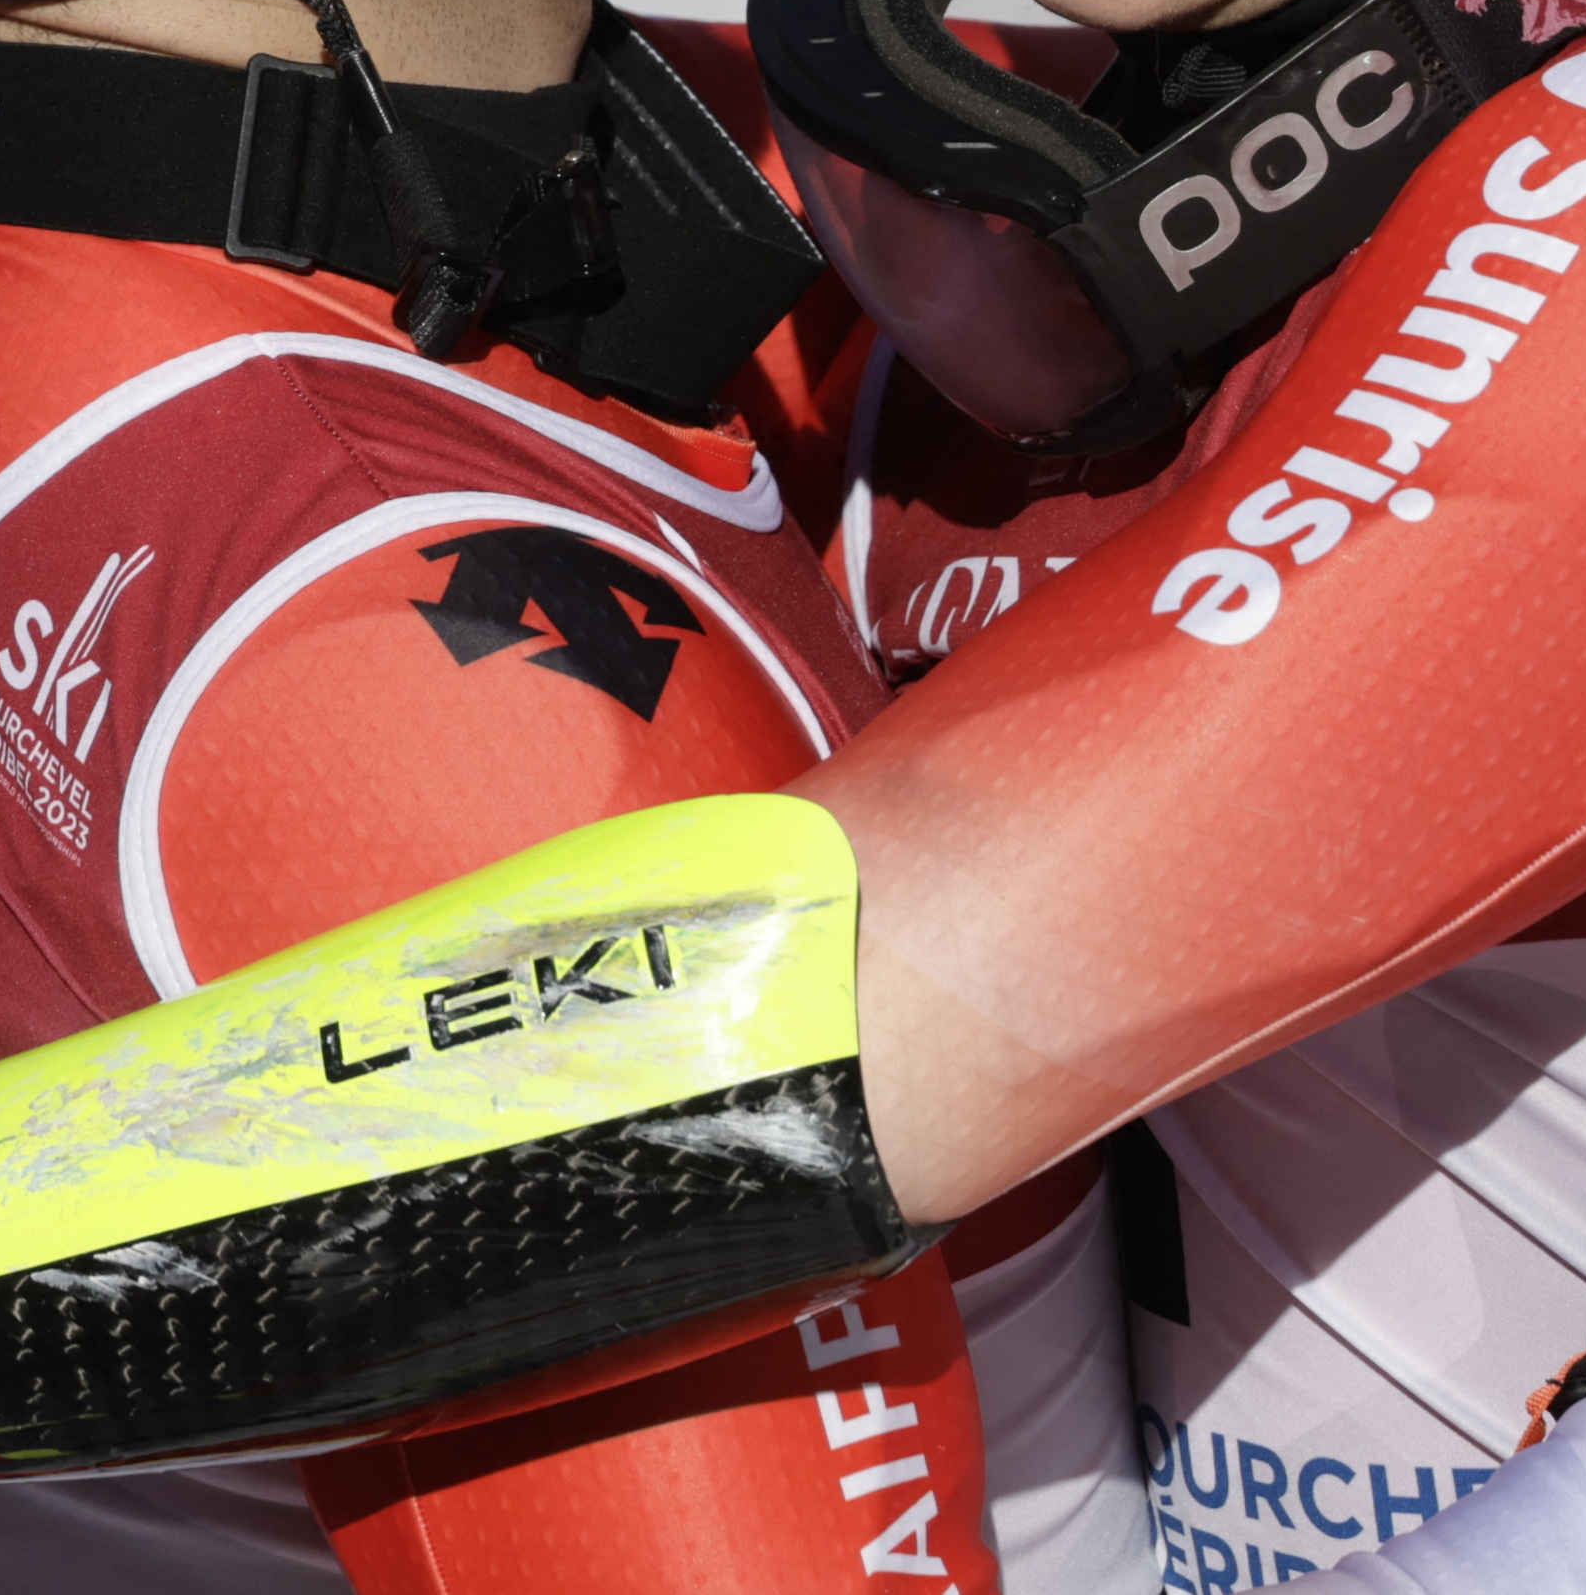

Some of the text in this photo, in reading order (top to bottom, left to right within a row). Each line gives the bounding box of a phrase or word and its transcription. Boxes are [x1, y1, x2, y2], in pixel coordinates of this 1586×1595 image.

[33, 786, 89, 850] 2023
[320, 924, 676, 1083] LEKI
[794, 1298, 962, 1595] AIFF
